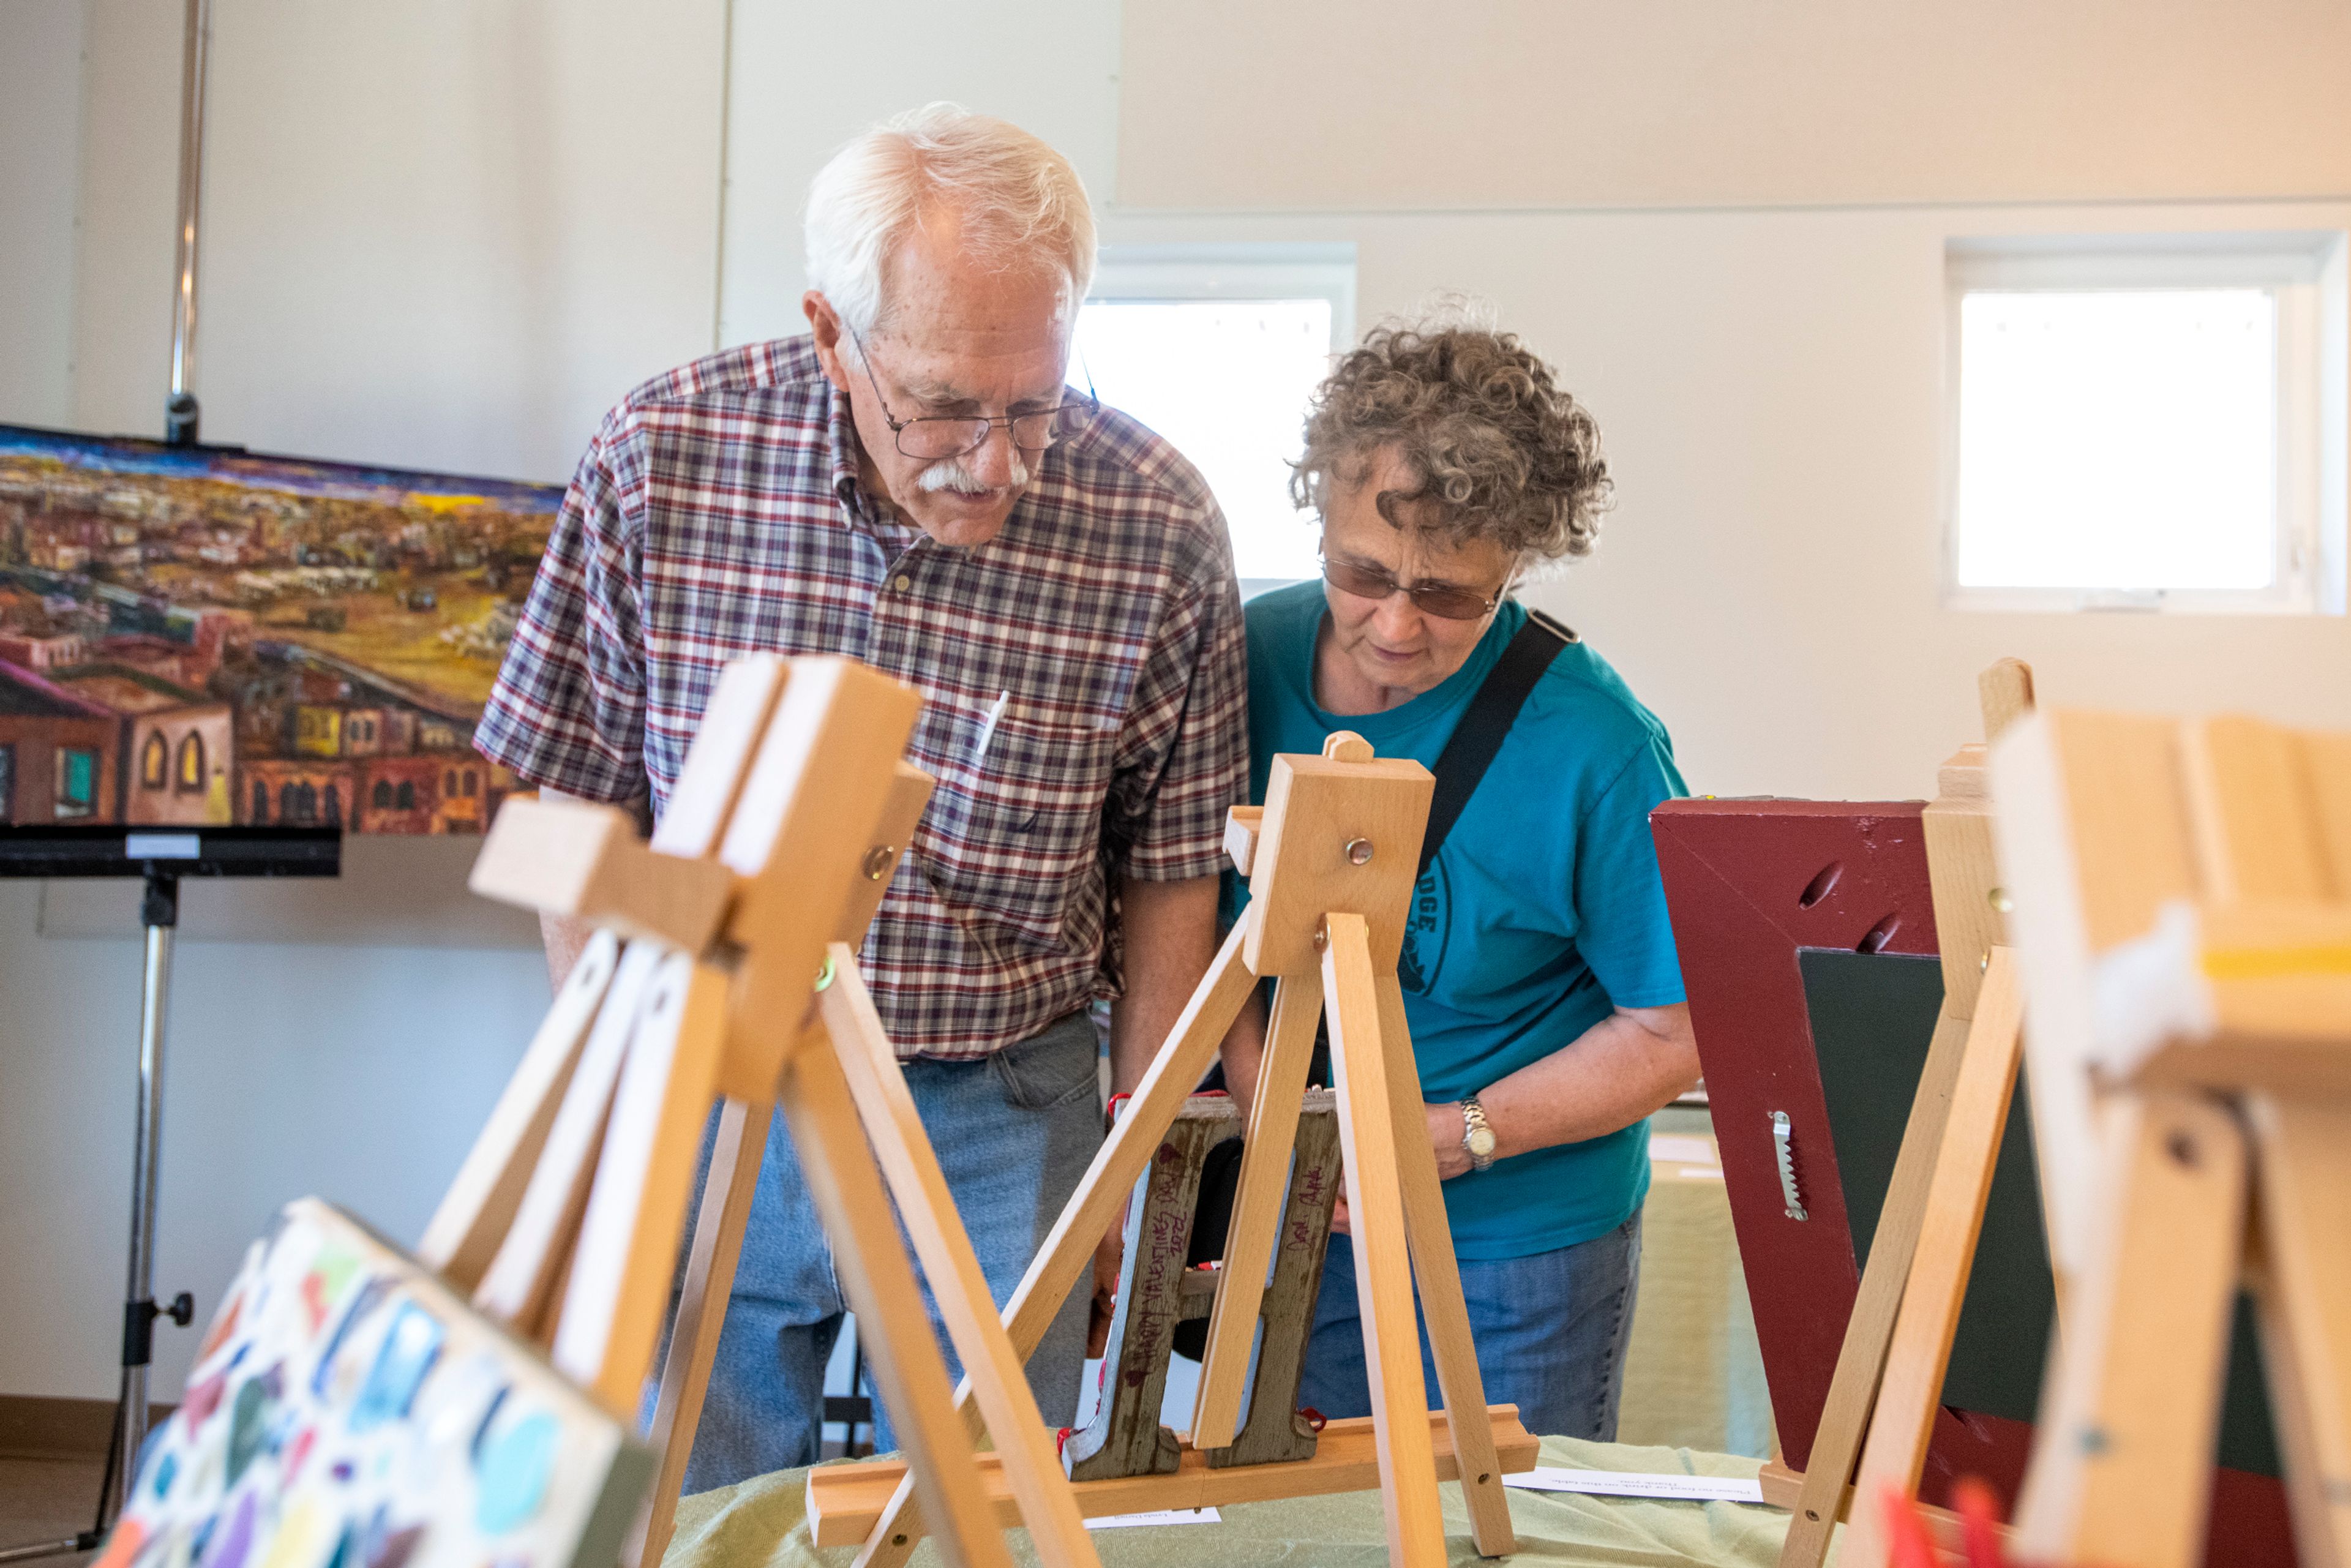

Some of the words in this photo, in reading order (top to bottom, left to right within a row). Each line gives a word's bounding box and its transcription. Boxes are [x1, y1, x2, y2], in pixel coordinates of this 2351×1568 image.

[1418, 876, 1438, 932] DGE
[1155, 1171, 1188, 1204] DAY
[1142, 1211, 1177, 1305] VALENTINES
[1169, 1210, 1188, 1258] 2022
[1133, 1311, 1173, 1363] HAPPY
